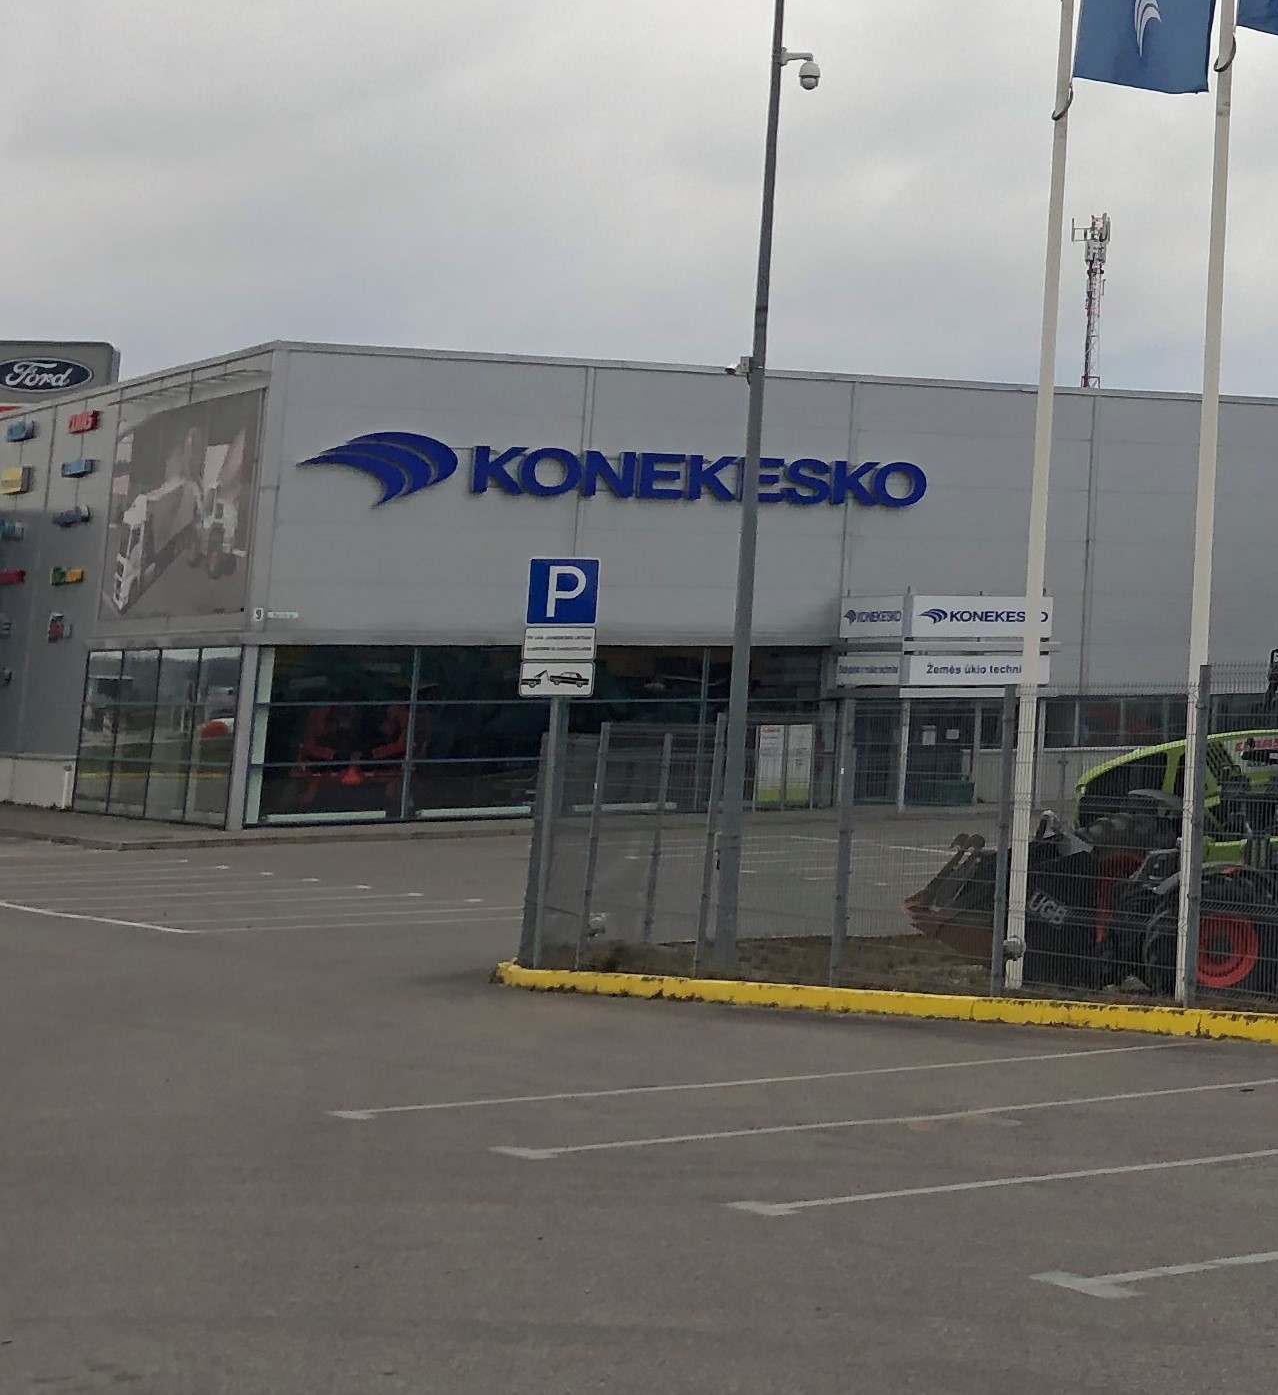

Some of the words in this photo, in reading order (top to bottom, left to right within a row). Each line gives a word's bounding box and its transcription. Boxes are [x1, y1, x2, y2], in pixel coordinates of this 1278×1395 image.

[5, 361, 73, 386] Ford
[470, 445, 927, 507] KONEKESKO
[546, 565, 587, 618] P
[949, 611, 1049, 623] KONEKESO
[989, 663, 1022, 674] techni
